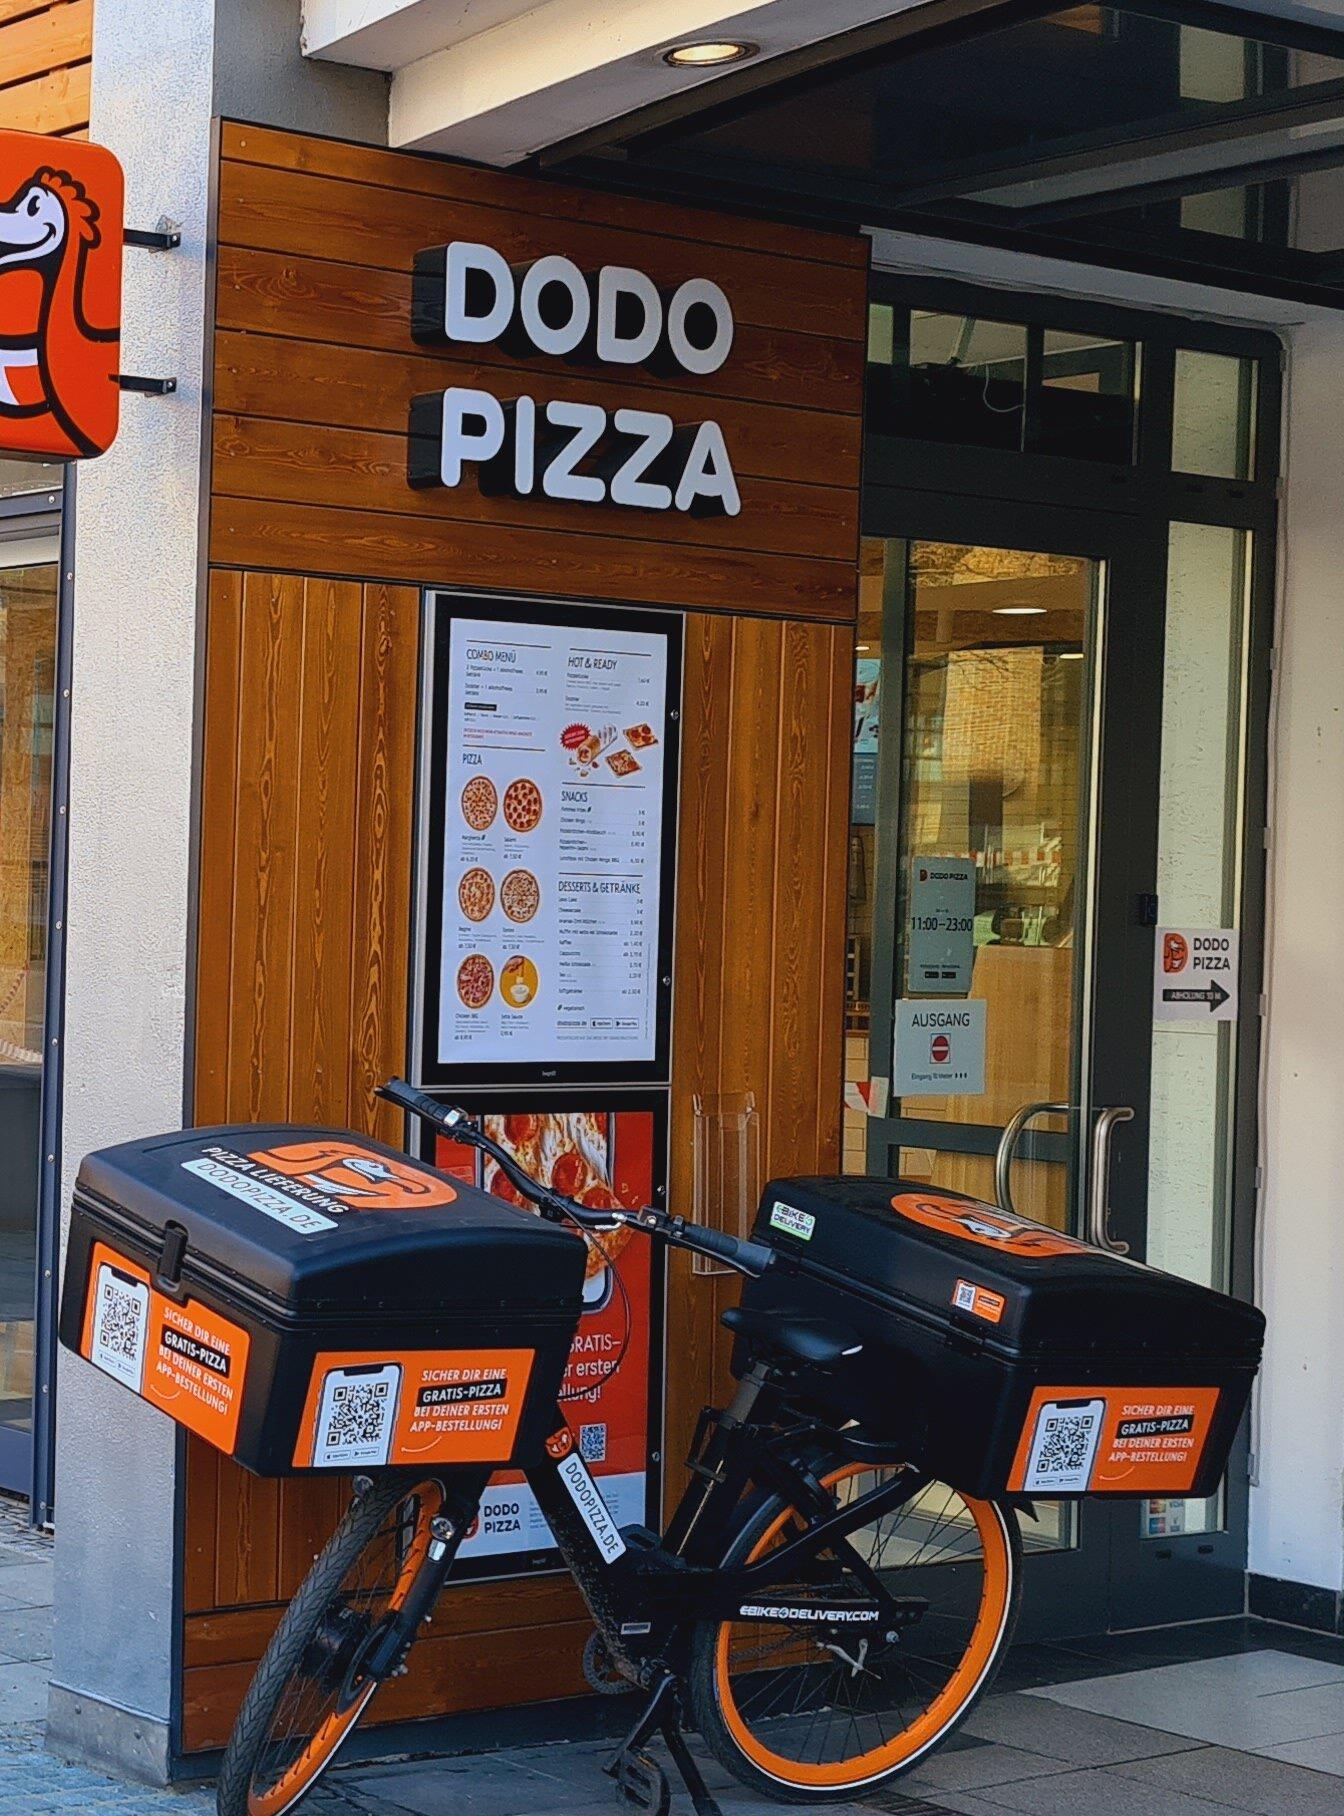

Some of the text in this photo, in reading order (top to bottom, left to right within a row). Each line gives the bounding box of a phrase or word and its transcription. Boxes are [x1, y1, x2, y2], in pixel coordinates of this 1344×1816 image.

[445, 241, 733, 374] DODO
[441, 387, 741, 516] PIZZA
[568, 657, 618, 670] HOT & READY
[462, 753, 483, 765] PIZZA
[561, 790, 588, 802] SNACKS
[558, 881, 591, 893] DESSERTS
[600, 880, 641, 894] GETRÄNKE
[1193, 938, 1230, 951] DODO
[1193, 957, 1231, 970] PIZZA
[912, 1013, 970, 1027] AUSGANG
[201, 1147, 350, 1214] PIZZA LIEFERUNG
[197, 1163, 324, 1229] DODOPIZZA.DE
[163, 1307, 230, 1354] SICHER DIR EINE
[570, 1333, 622, 1353] RATIS-
[164, 1331, 227, 1373] GRATIS-PIZZA
[158, 1345, 233, 1401] BEI DEINER ERSTEN
[421, 1368, 507, 1381] SICHER DIR EINE
[156, 1362, 229, 1415] APP-BESTELLUNG!
[422, 1383, 502, 1403] GRATIS-PIZZA
[413, 1405, 509, 1417] BEI DEINER ERSTEN
[1122, 1405, 1195, 1415] SICHER DIR EINE
[410, 1419, 502, 1433] APP-BESTELLUNG!
[1121, 1419, 1189, 1435] GRATIS-PIZZA
[1112, 1438, 1194, 1448] BEI DEINER ERSTEN
[1109, 1452, 1188, 1462] APP-BESTELLUNG!
[484, 1503, 520, 1517] DODO
[565, 1462, 619, 1554] DODOPIZZA.DE
[484, 1520, 521, 1534] PIZZA
